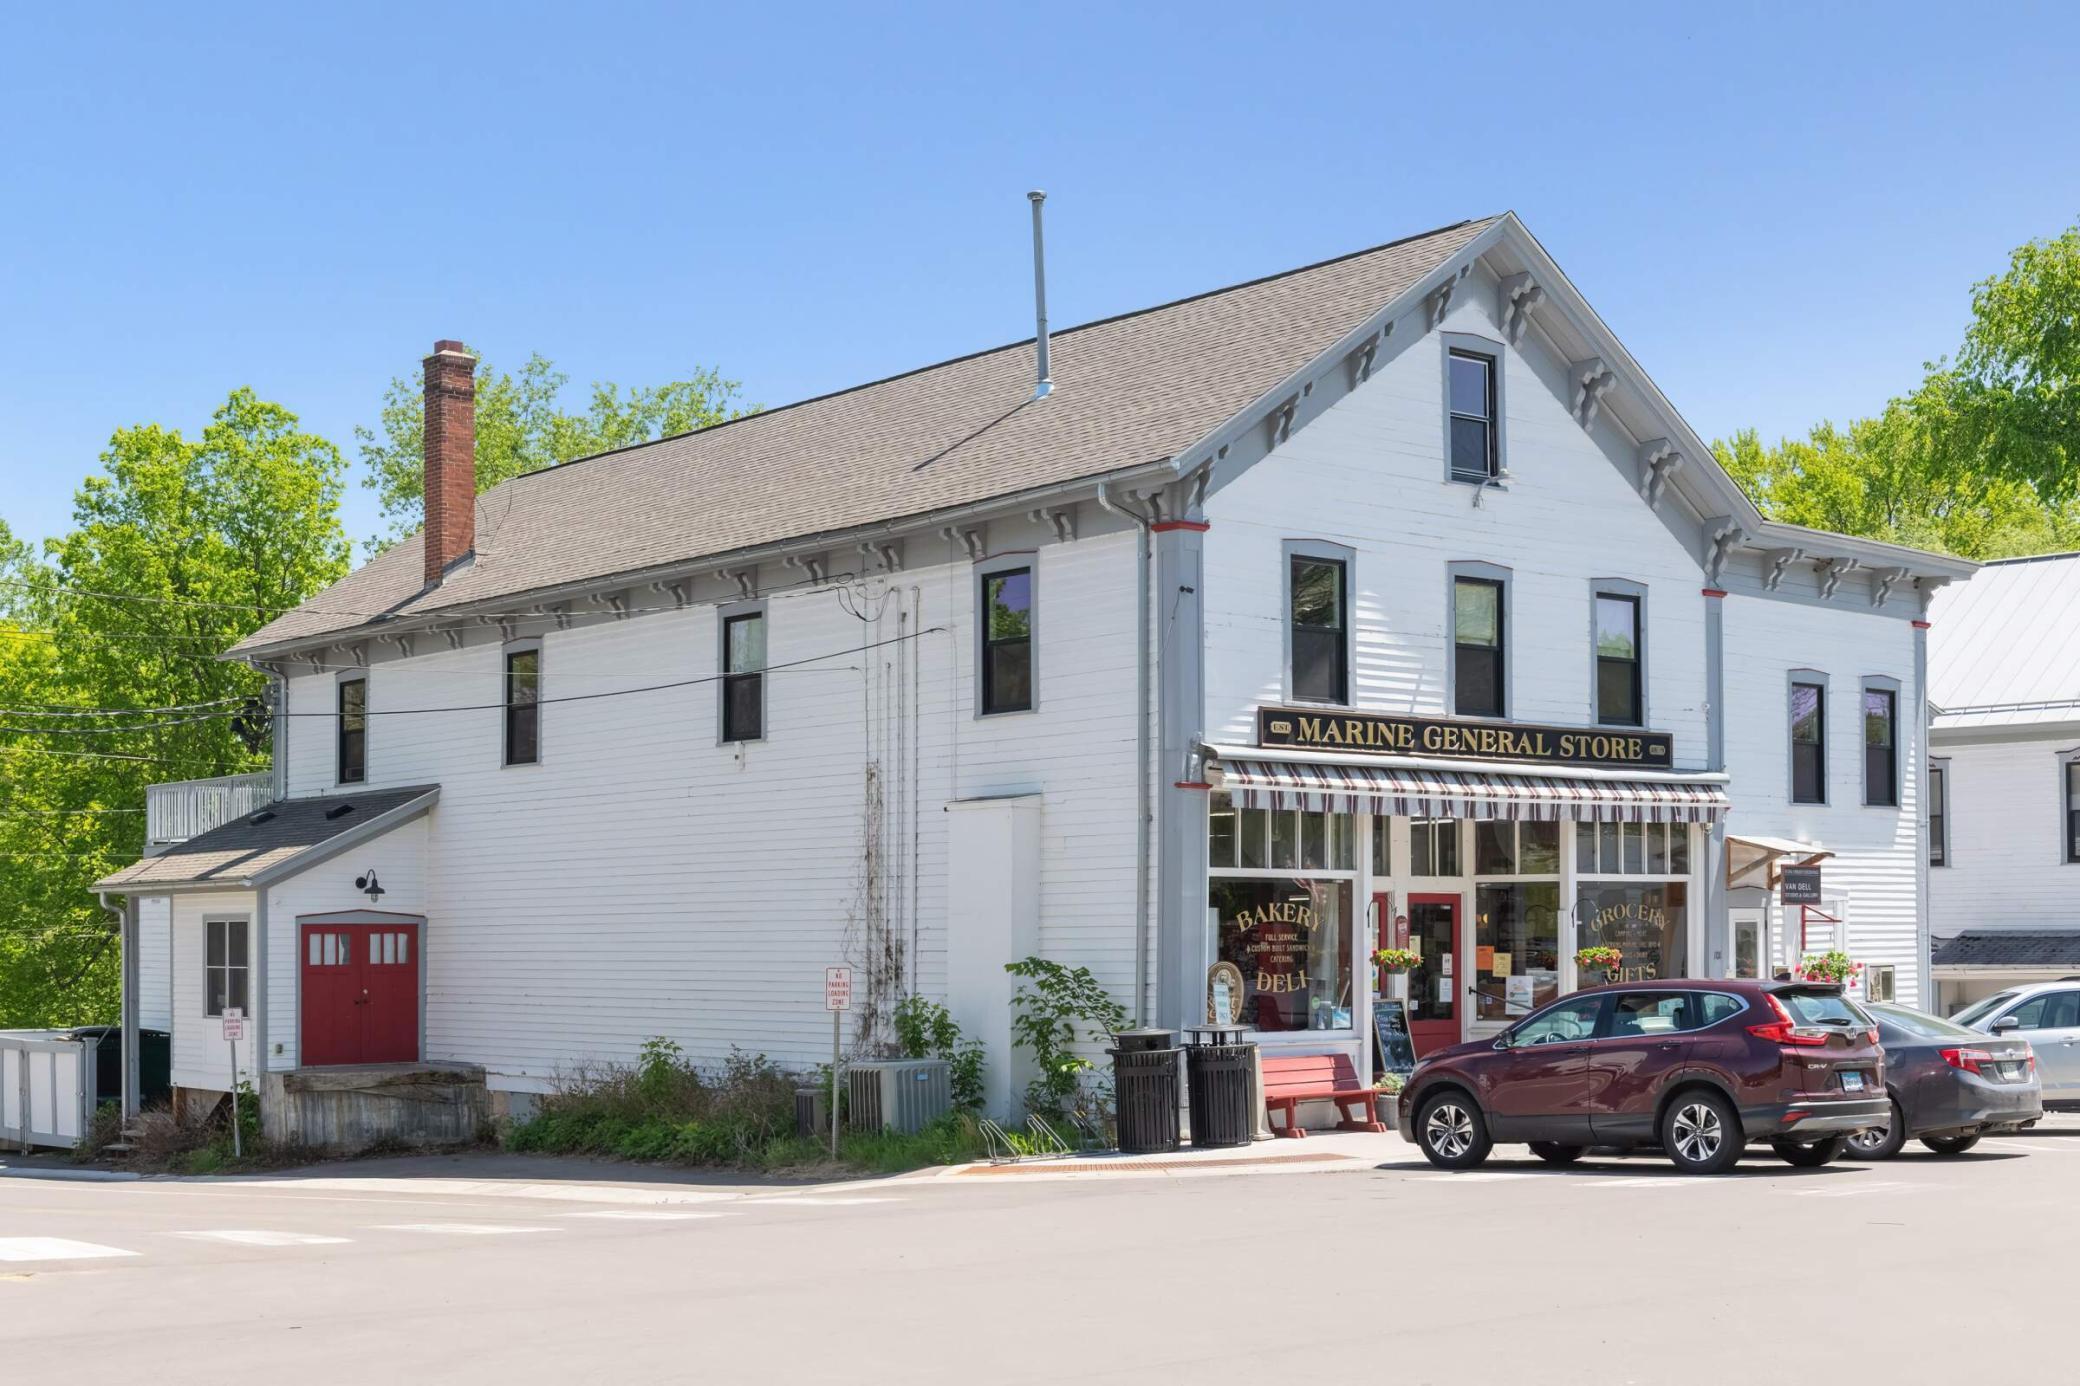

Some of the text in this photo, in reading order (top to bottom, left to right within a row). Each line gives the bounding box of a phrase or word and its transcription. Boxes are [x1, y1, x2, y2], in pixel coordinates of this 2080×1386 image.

[1297, 717, 1415, 749] MARINE
[1423, 725, 1551, 756] GENERAL
[1559, 734, 1643, 760] STORE
[1236, 902, 1324, 932] BAKERY
[1591, 903, 1670, 932] GROCERY
[1279, 933, 1298, 942] SERVICE
[1256, 969, 1307, 993] DELI
[1606, 962, 1657, 984] GIFTS
